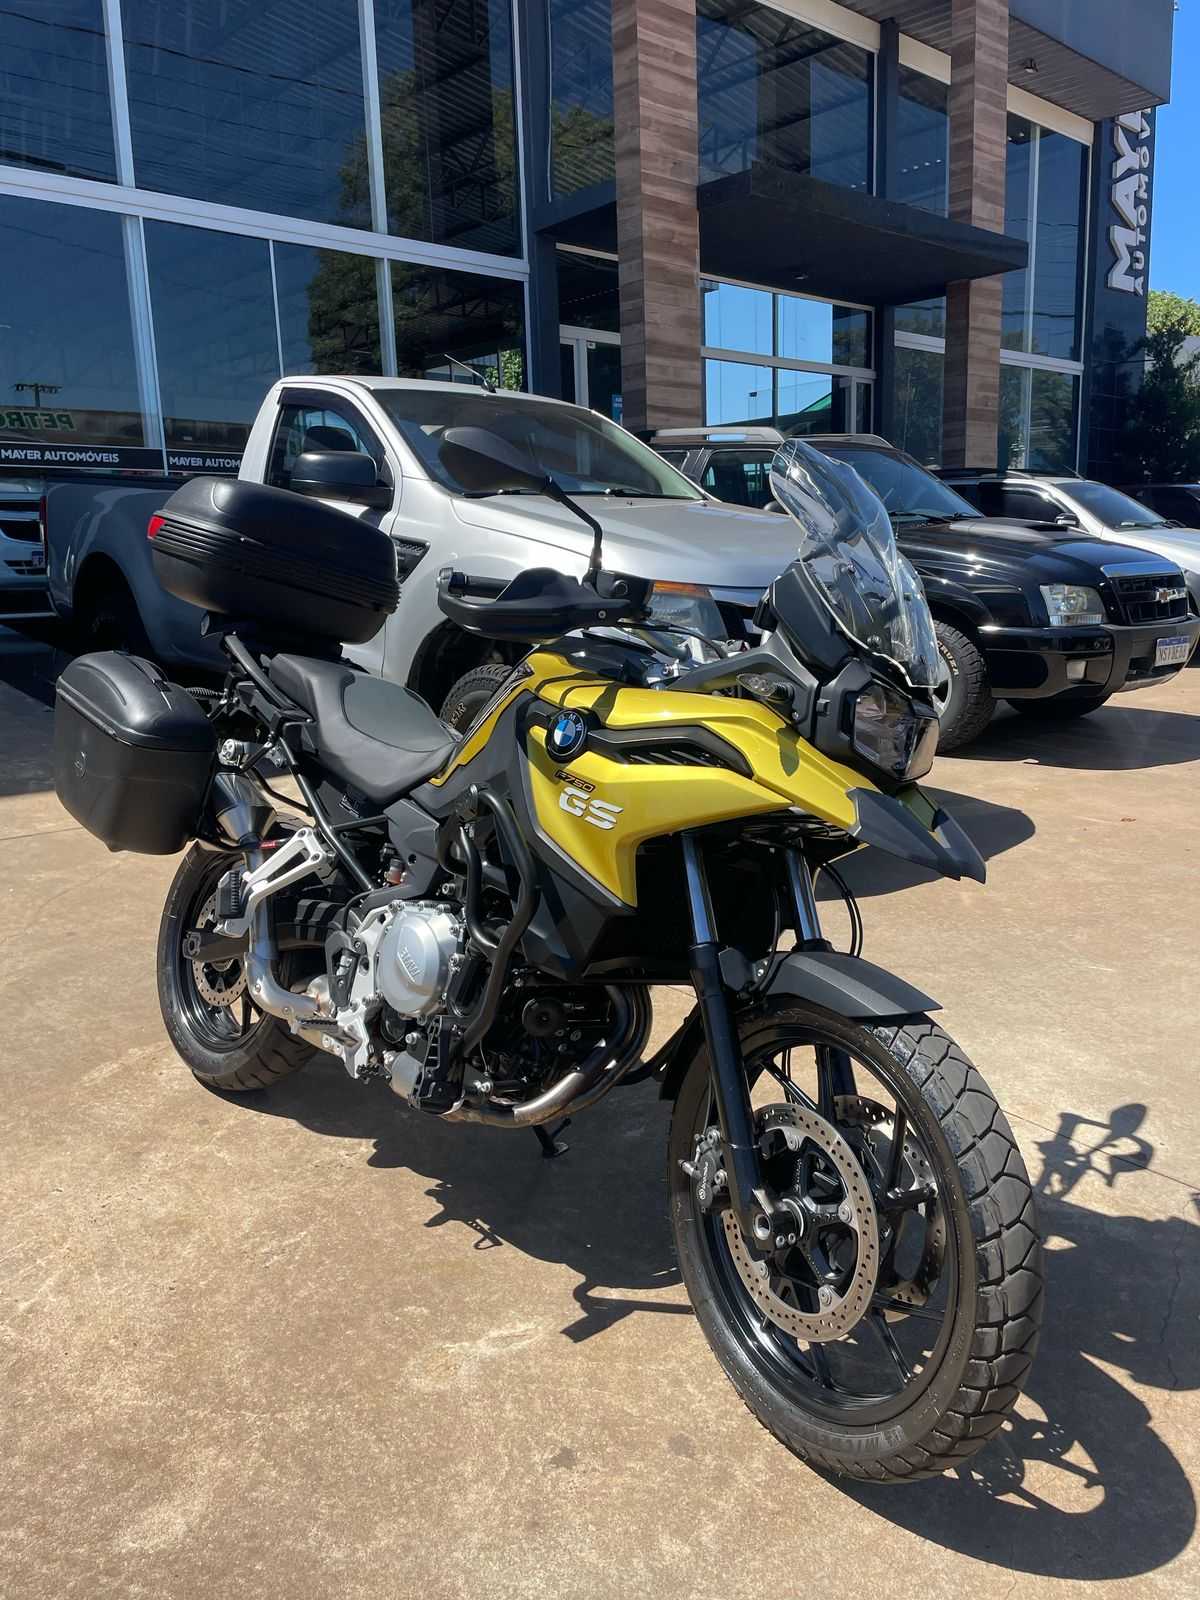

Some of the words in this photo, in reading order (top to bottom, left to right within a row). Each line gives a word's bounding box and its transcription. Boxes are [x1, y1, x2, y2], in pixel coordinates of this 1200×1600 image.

[1133, 108, 1151, 296] AUTOMÓV
[0, 449, 42, 460] MAYER
[44, 450, 119, 463] AUTOMÓVEIS
[169, 456, 203, 467] MAYER
[558, 712, 583, 731] BMW
[555, 769, 596, 793] F750
[559, 786, 624, 830] GS
